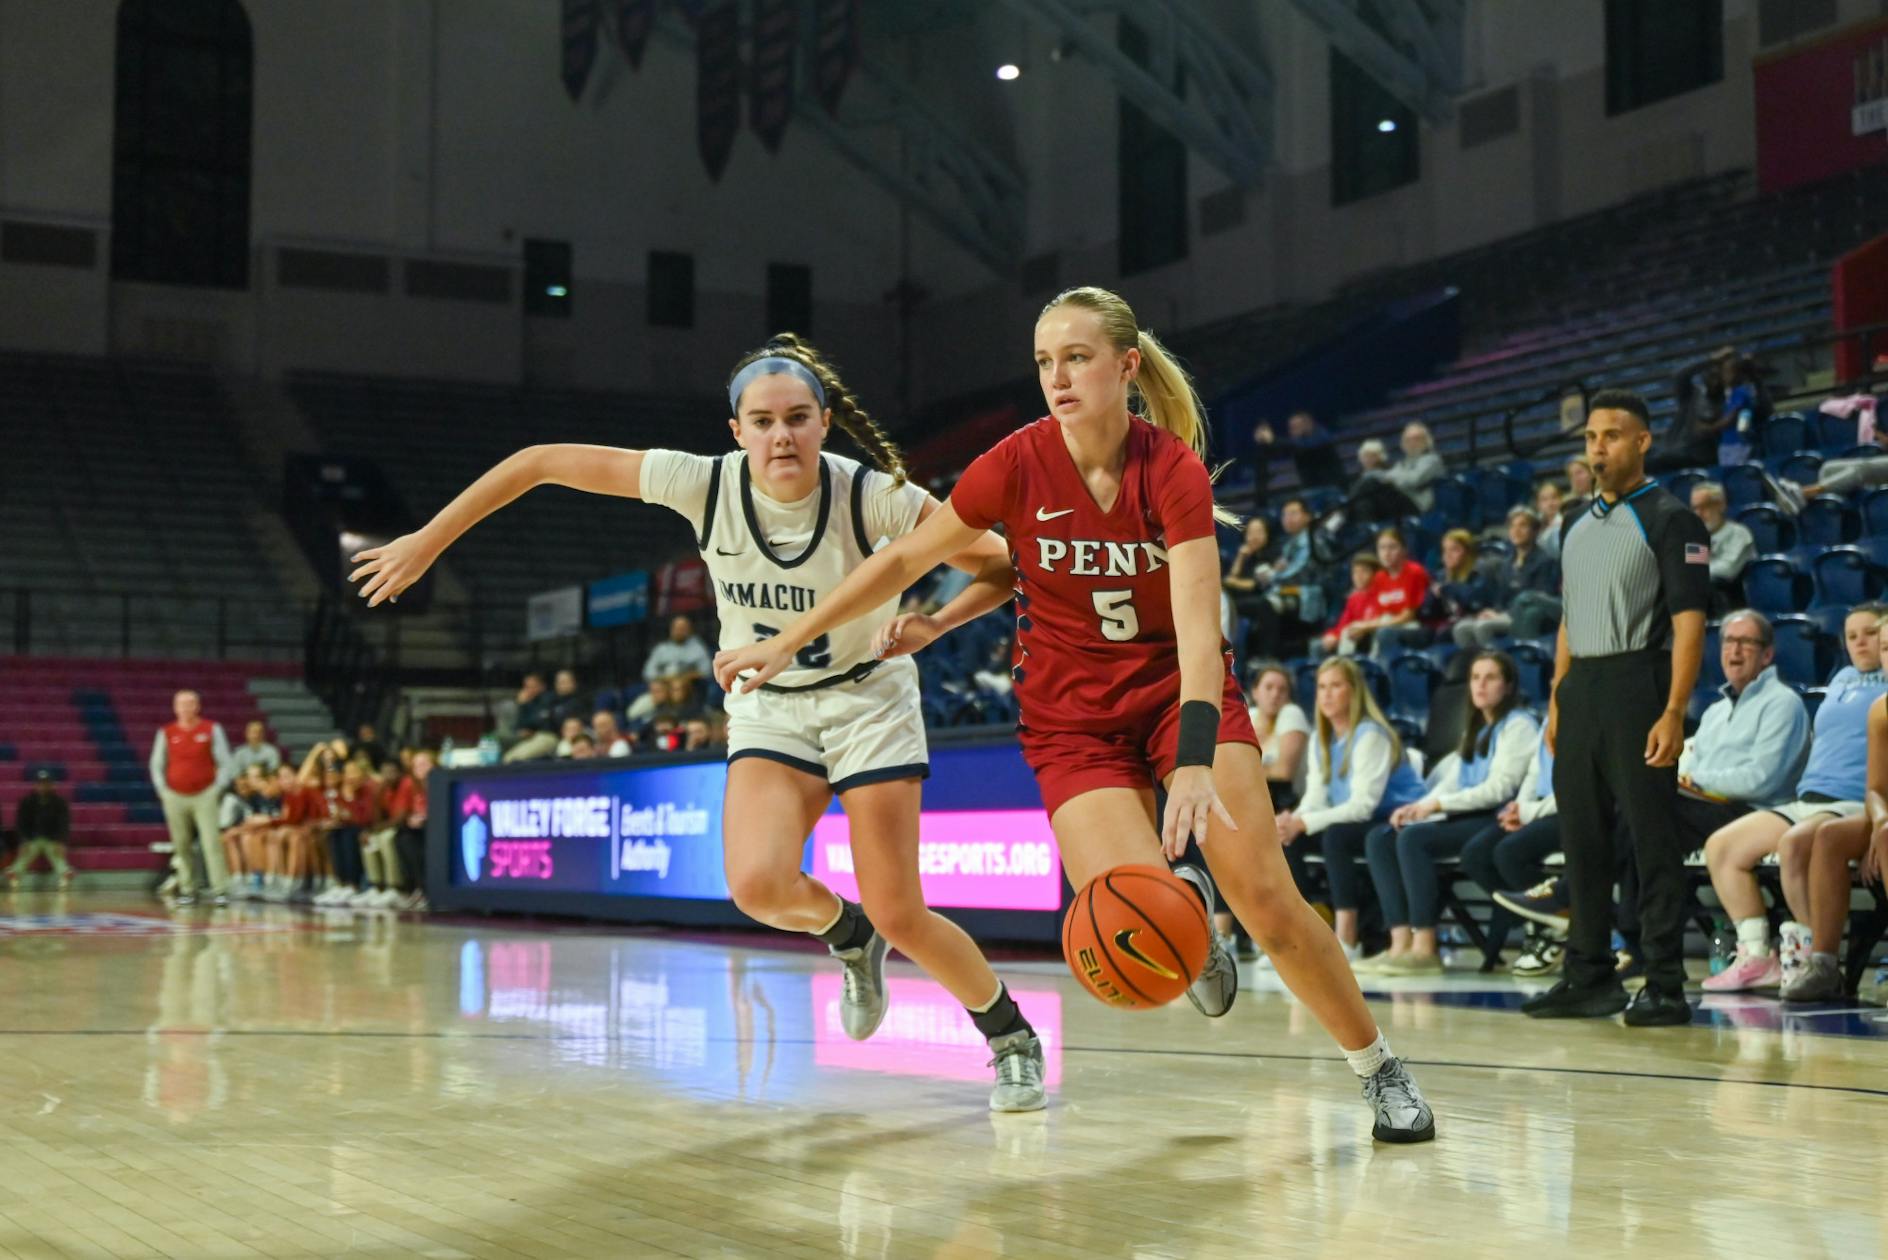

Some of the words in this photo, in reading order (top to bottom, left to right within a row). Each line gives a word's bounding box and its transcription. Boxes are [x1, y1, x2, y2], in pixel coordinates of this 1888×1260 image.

[1092, 590, 1139, 641] 5
[490, 799, 551, 838] VALLEY
[552, 796, 610, 838] FORGE
[490, 841, 553, 878] SPORTS
